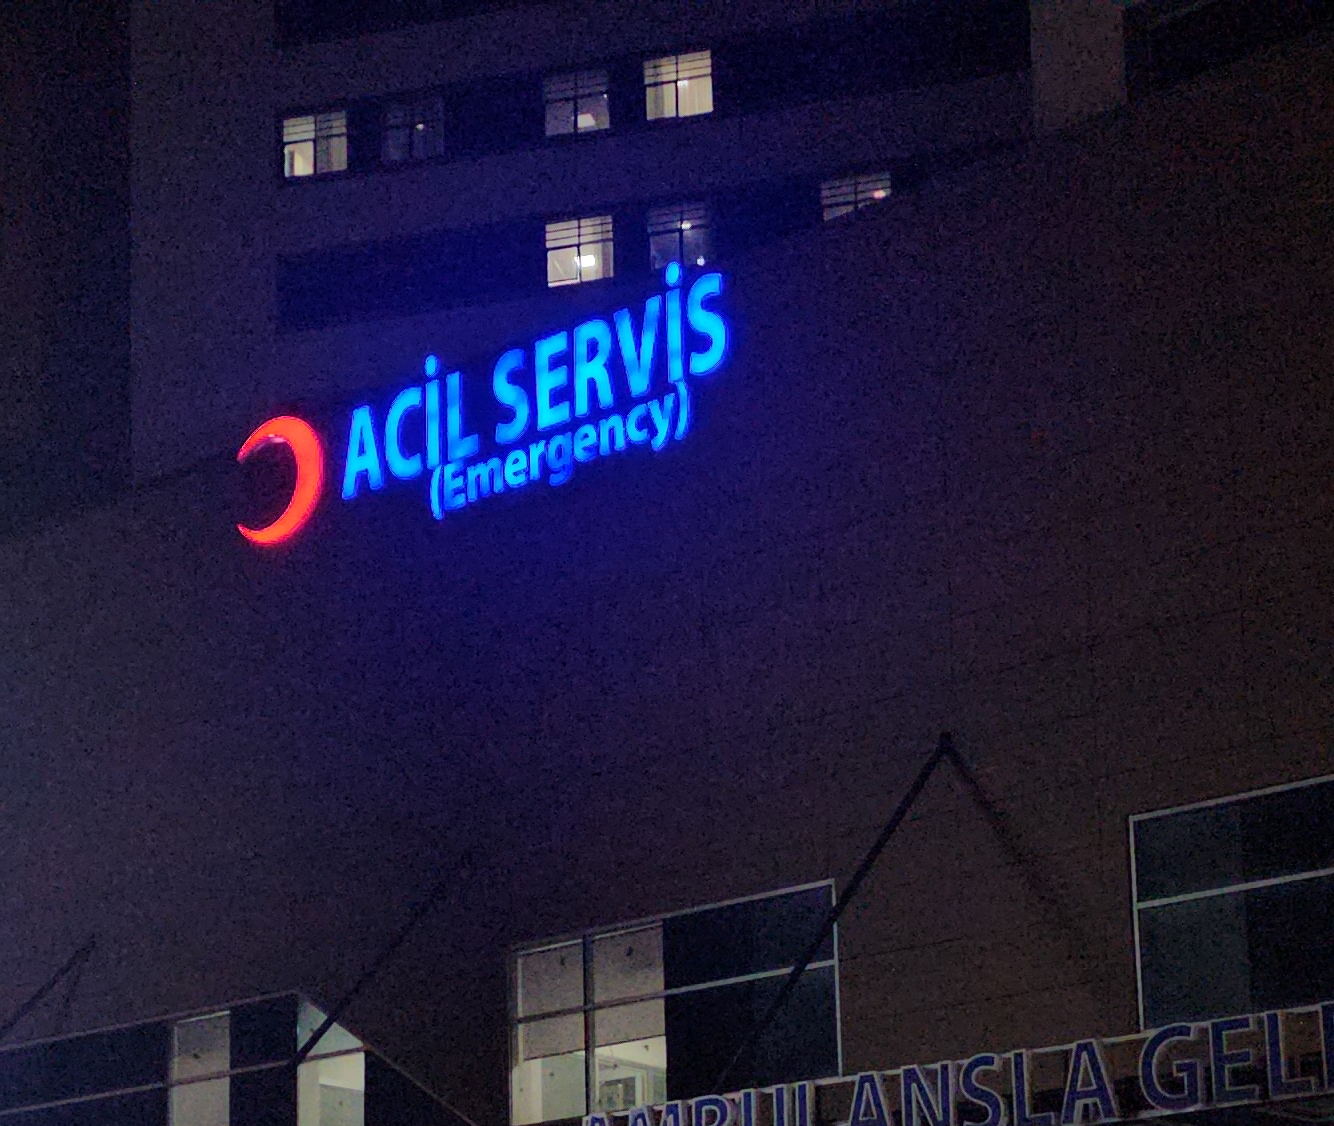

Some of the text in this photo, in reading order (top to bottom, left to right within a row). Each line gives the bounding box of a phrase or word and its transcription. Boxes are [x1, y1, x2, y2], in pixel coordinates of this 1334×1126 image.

[341, 261, 729, 500] ACİL SERVİS
[430, 380, 692, 520] (Emergency)
